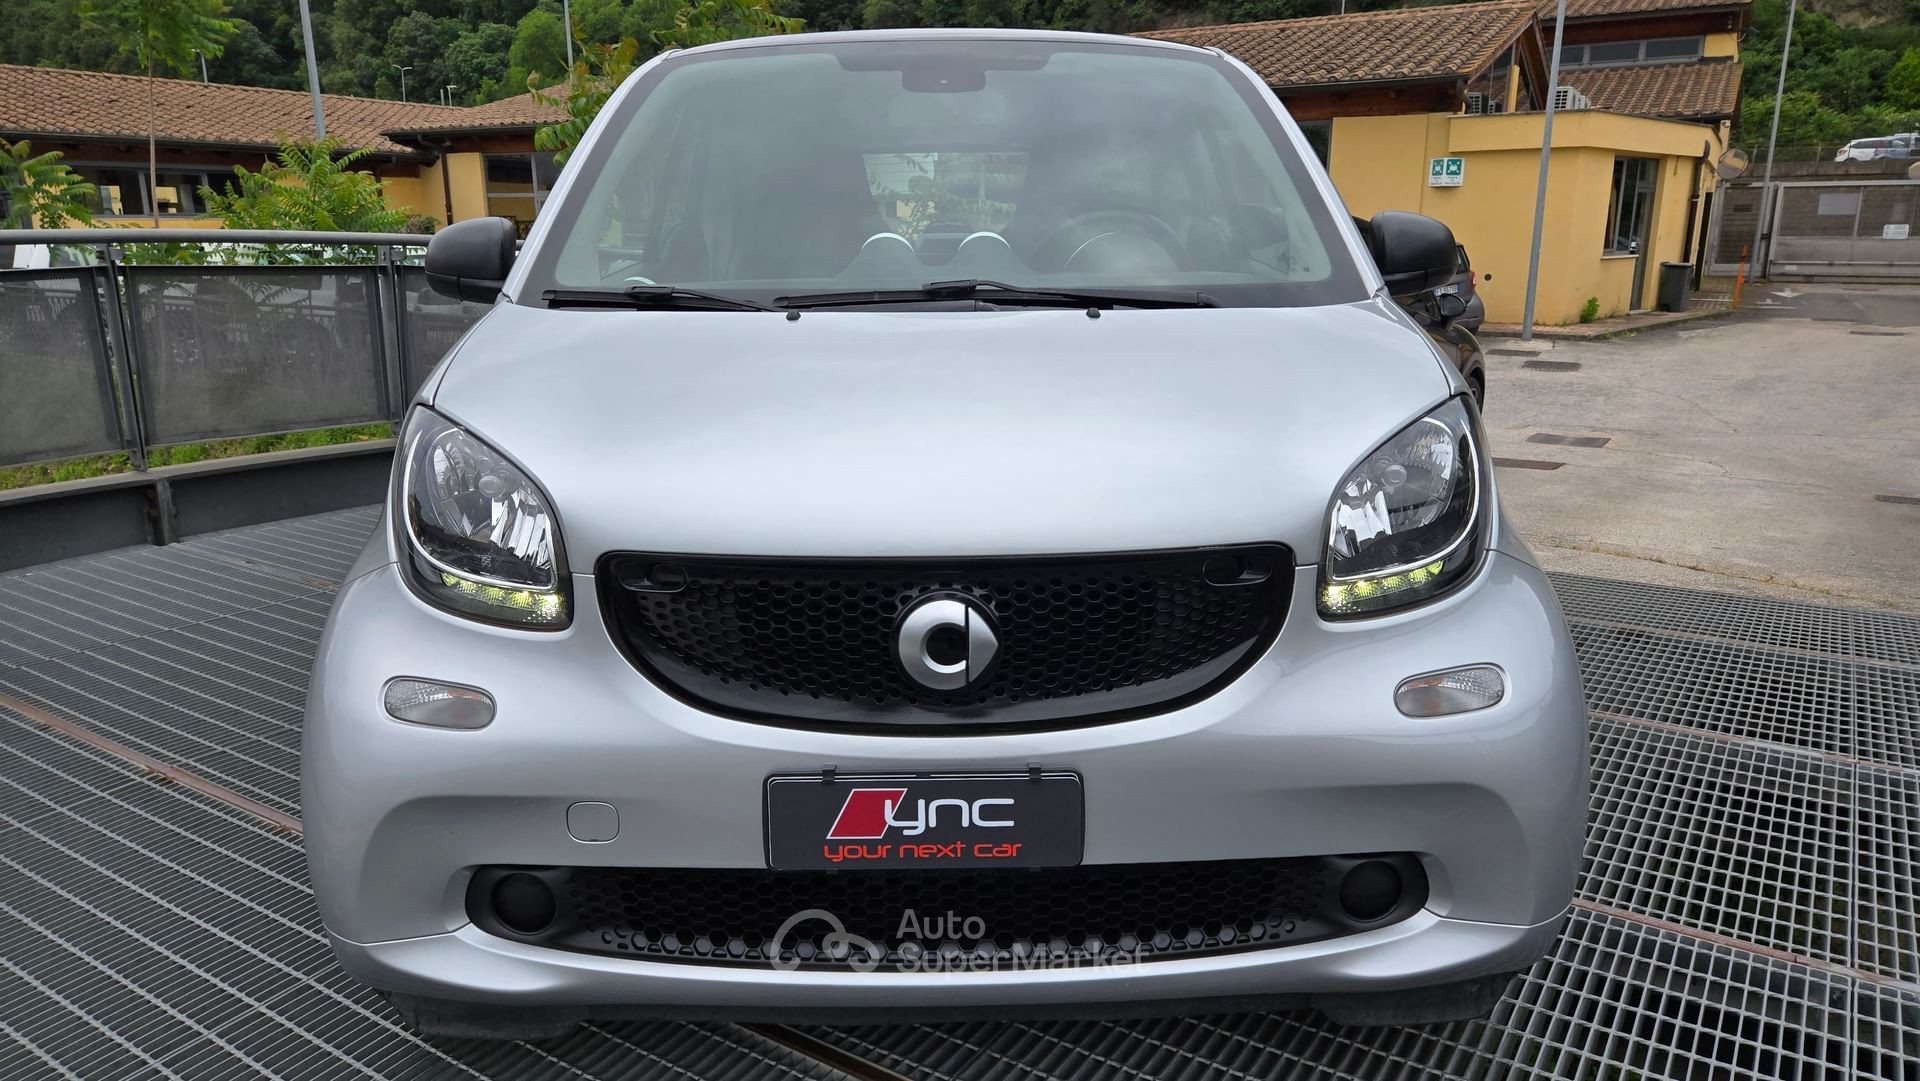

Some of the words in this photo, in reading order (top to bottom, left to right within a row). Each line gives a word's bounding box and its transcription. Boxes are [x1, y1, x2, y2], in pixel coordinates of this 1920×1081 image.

[884, 798, 1015, 836] ync
[823, 843, 892, 862] your
[899, 841, 967, 858] next
[973, 843, 1022, 858] car
